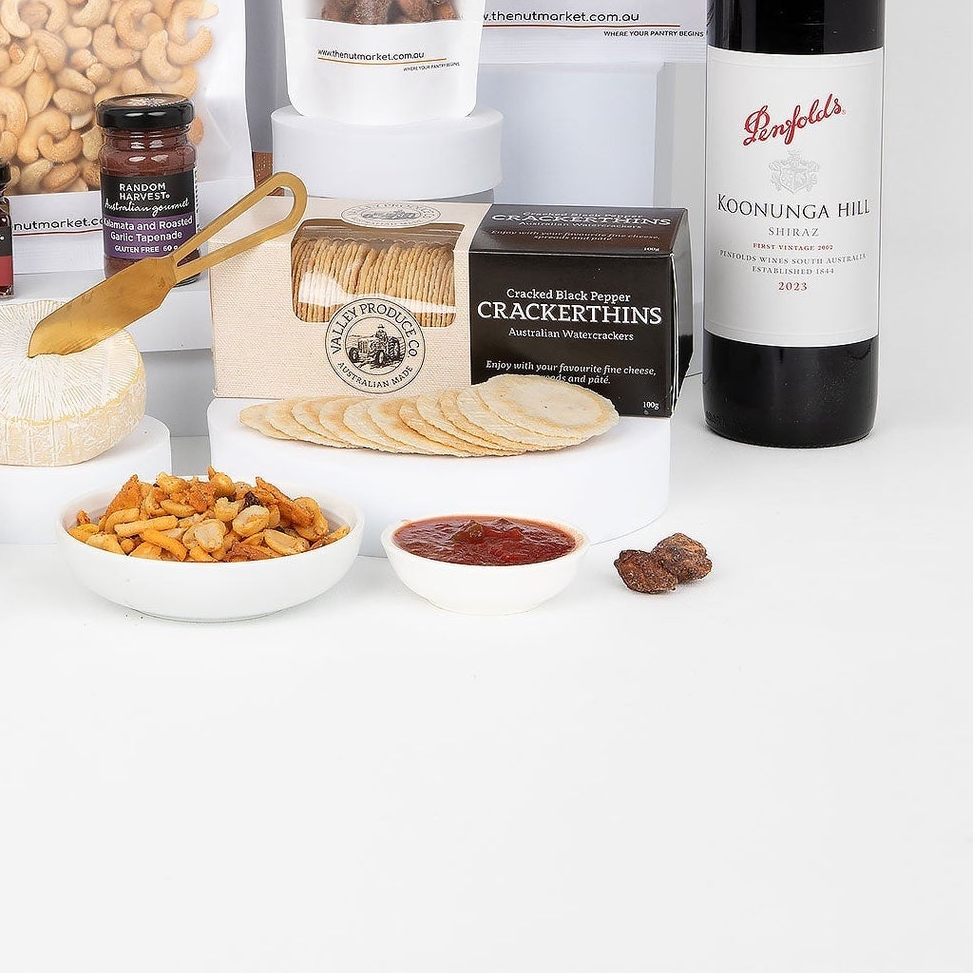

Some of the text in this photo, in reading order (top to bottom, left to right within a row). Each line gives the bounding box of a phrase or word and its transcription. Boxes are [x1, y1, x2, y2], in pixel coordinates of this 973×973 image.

[483, 10, 640, 23] .thenutmarket.com.au
[678, 30, 704, 38] BEGINS
[119, 182, 166, 192] RANDOM
[104, 197, 190, 217] Australian gourmet
[717, 193, 870, 220] KOONUNGA HILL
[136, 220, 156, 231] and
[159, 215, 193, 230] Roasted
[491, 214, 672, 226] CRACKERTHINS
[110, 231, 183, 244] Garlic Tapenade
[768, 227, 820, 237] SHIRAZ
[114, 245, 173, 254] GLUTEN FREE 60
[752, 242, 776, 250] FIRST
[718, 249, 867, 265] PENFOLDS WINES SOUTH AUSTRALIA
[751, 265, 835, 275] ESTABLISHED 1844
[778, 281, 808, 292] 2023
[506, 288, 632, 305] Cracked Black Pepper
[476, 300, 663, 326] CRACKERTHINS
[330, 305, 358, 355] VALLEY
[359, 302, 418, 339] PRODUCE
[508, 327, 635, 342] Australian Watercrackers
[485, 359, 657, 377] Enjoy with your favourite fine cheese,
[337, 361, 414, 389] AUSTRALIAN MADE
[567, 374, 587, 384] and
[642, 401, 660, 411] 100g
